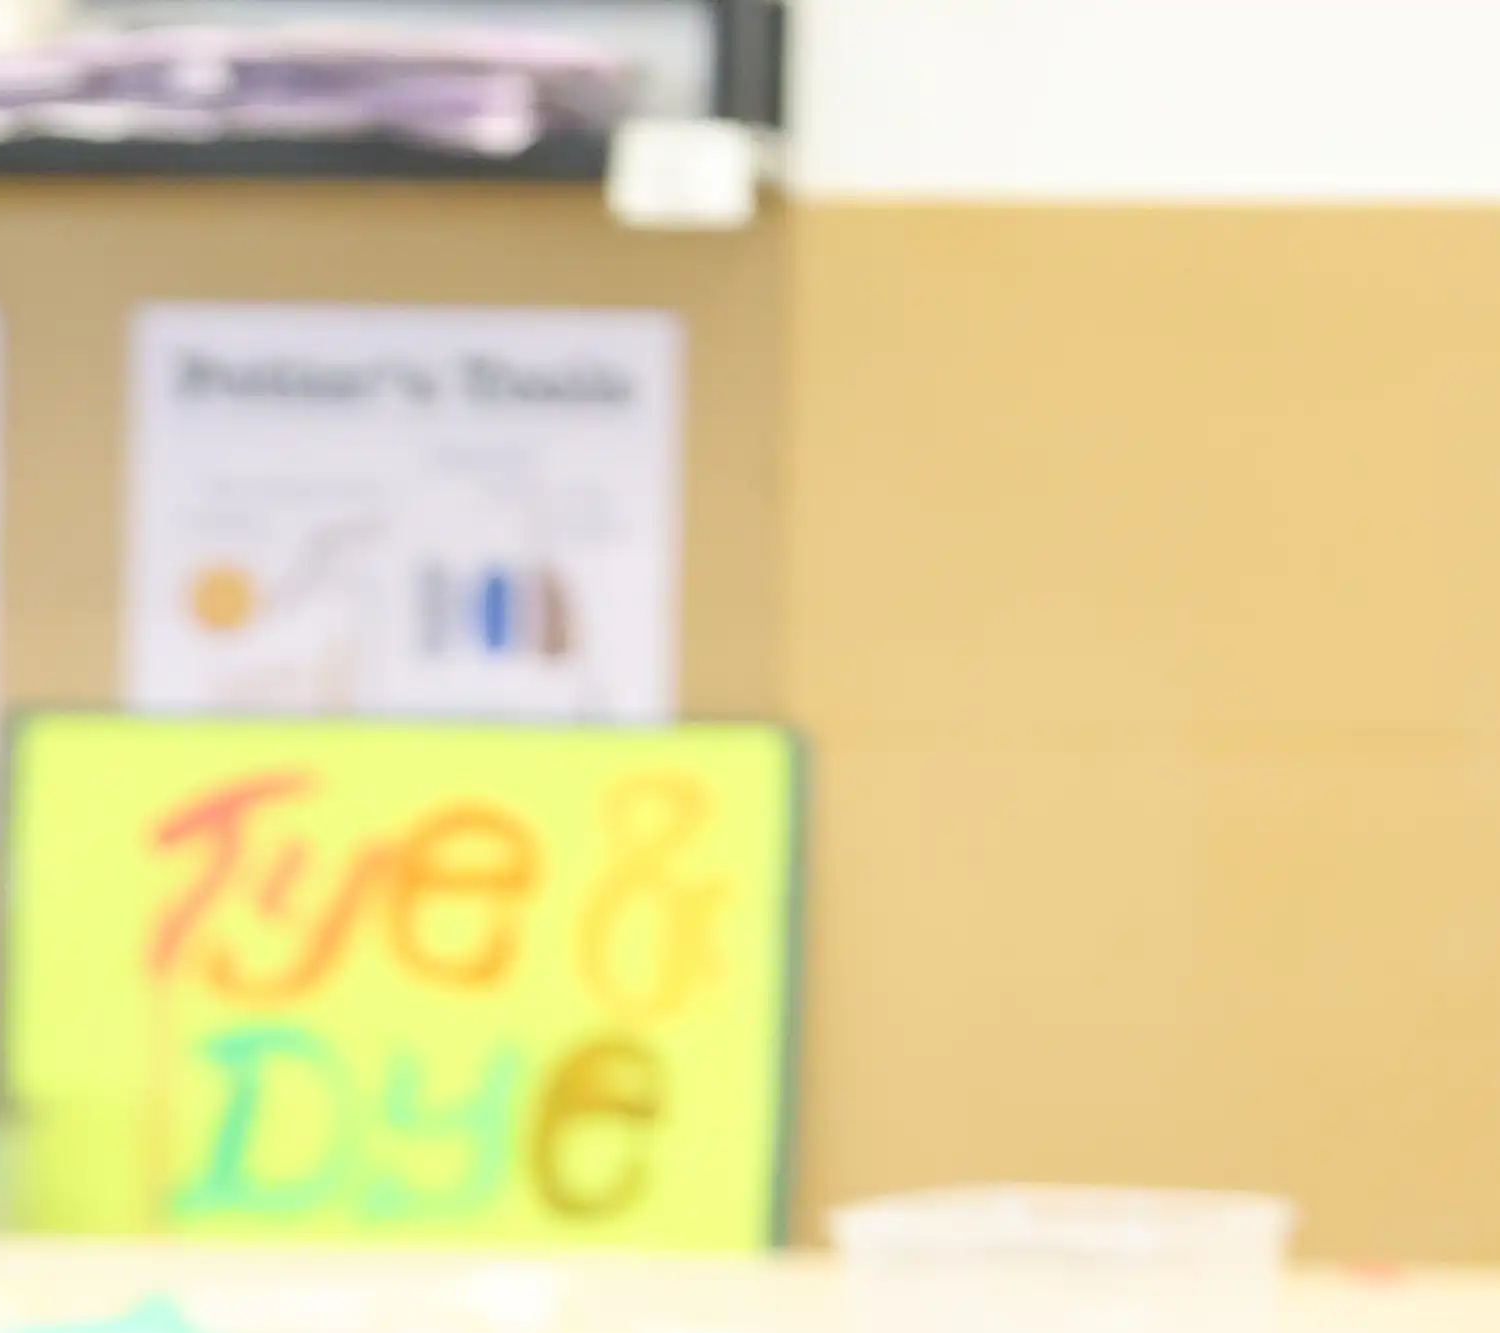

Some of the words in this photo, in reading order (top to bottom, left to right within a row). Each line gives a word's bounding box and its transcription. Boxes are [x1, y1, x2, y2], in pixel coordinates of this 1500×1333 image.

[149, 764, 545, 1010] Tye
[577, 770, 730, 1025] &
[173, 1023, 670, 1225] Dye
